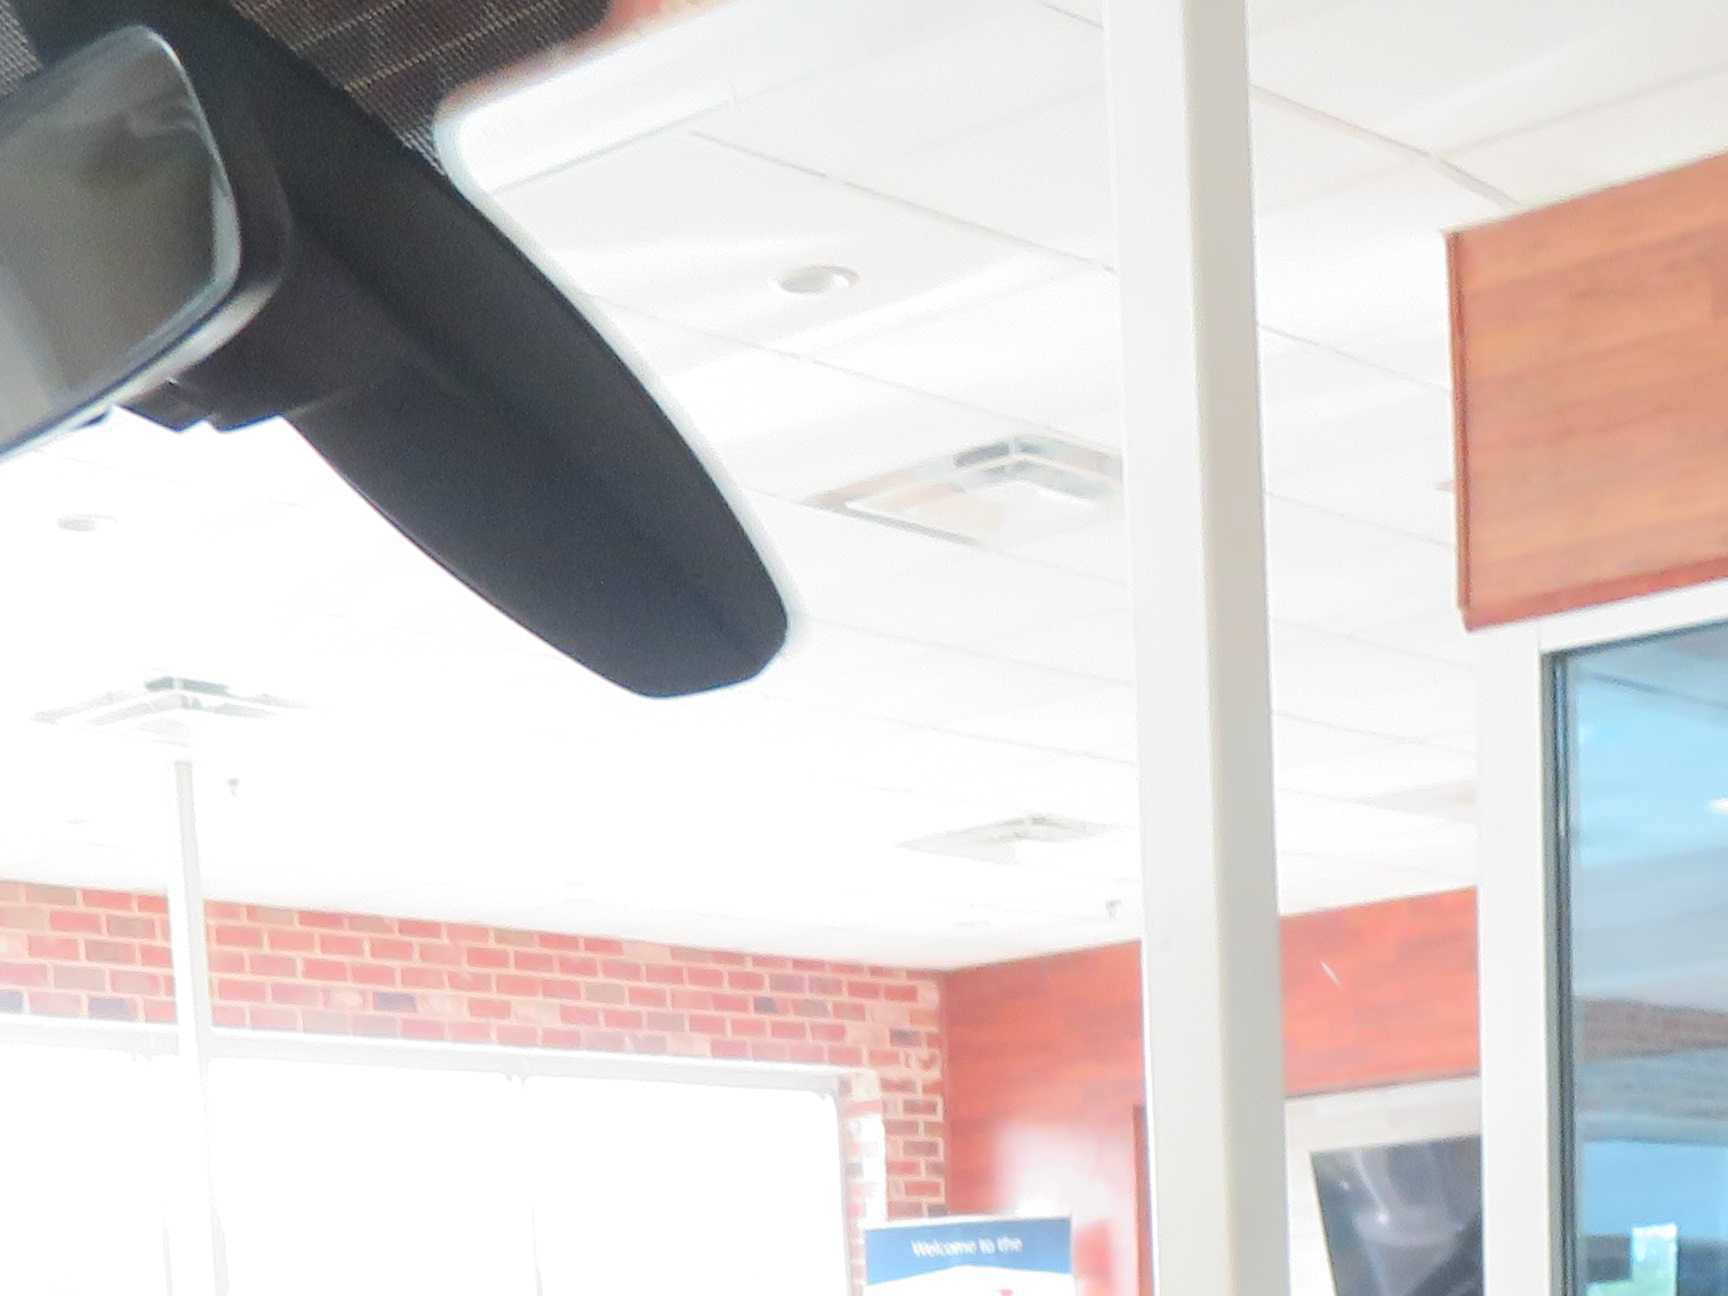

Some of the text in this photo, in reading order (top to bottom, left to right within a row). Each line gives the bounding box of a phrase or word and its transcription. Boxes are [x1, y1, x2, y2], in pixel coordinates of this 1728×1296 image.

[910, 1236, 1023, 1257] Welcome to the
